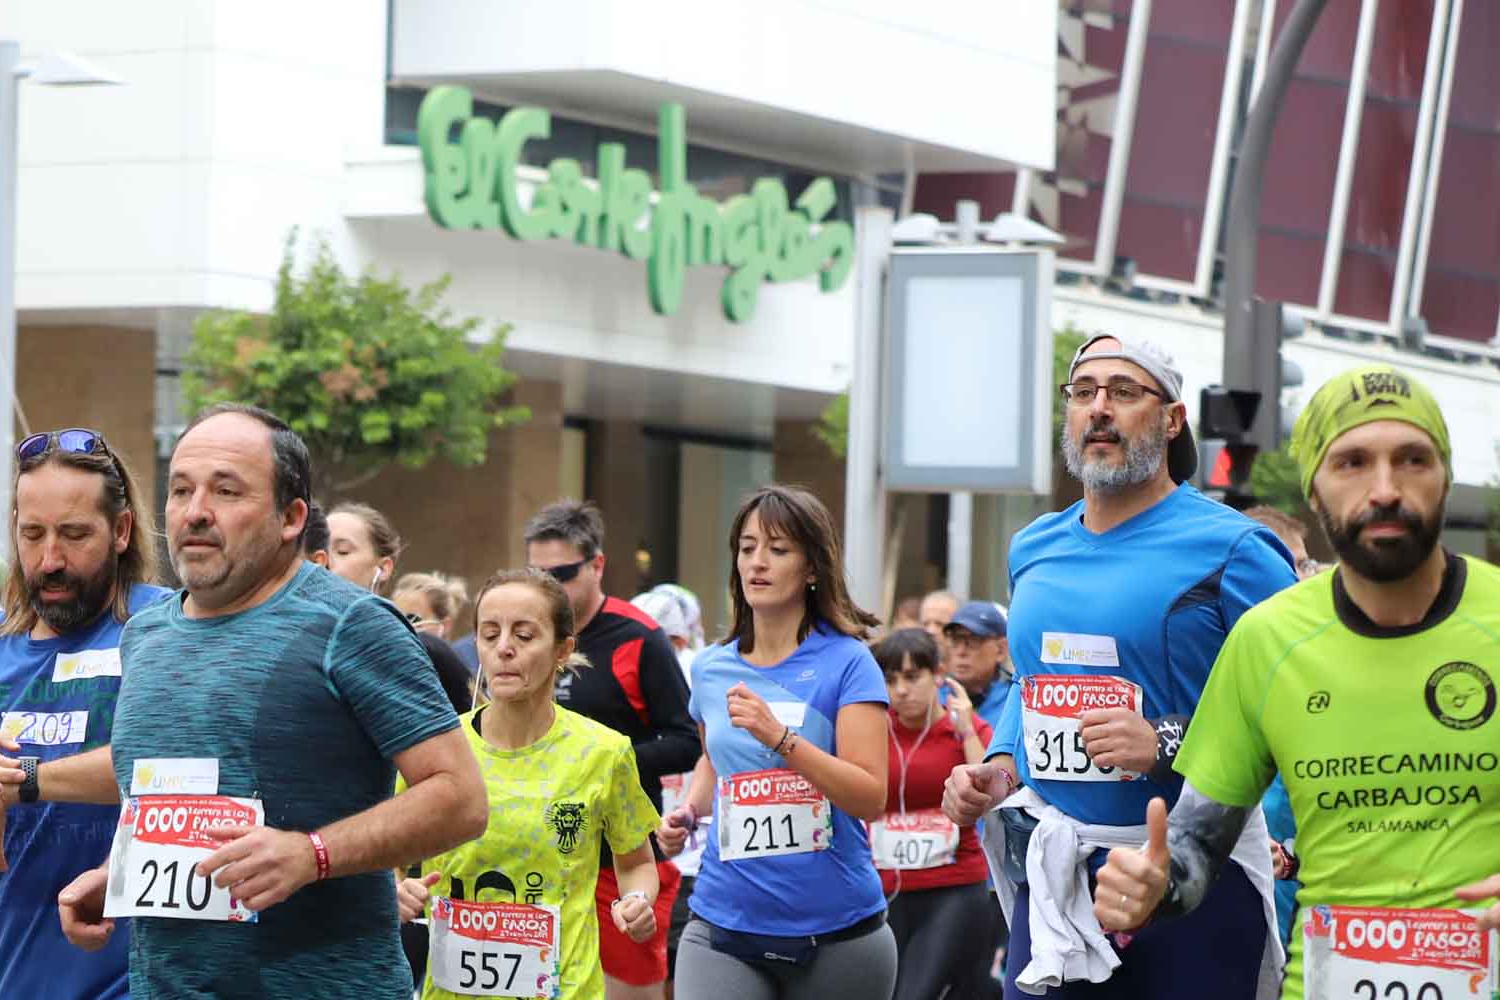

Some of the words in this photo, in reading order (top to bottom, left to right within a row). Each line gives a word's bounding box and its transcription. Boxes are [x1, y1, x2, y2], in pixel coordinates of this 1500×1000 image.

[495, 107, 653, 261] Corte
[647, 104, 855, 323] Inglés
[1031, 684, 1079, 708] 1.000
[1082, 692, 1129, 706] PASOS
[14, 712, 72, 745] 209
[1035, 729, 1116, 775] 315
[729, 778, 771, 802] 1.000
[1316, 784, 1482, 811] CARBAJOSA
[132, 807, 188, 836] 1.000
[743, 813, 800, 852] 211
[1347, 818, 1450, 835] SALAMANCA
[892, 839, 934, 865] 407
[135, 859, 212, 911] 210
[448, 907, 497, 931] 1.000
[502, 919, 549, 931] PASOS
[1330, 917, 1407, 950] 1.000
[1414, 931, 1481, 949] PASOS
[459, 949, 522, 990] 557
